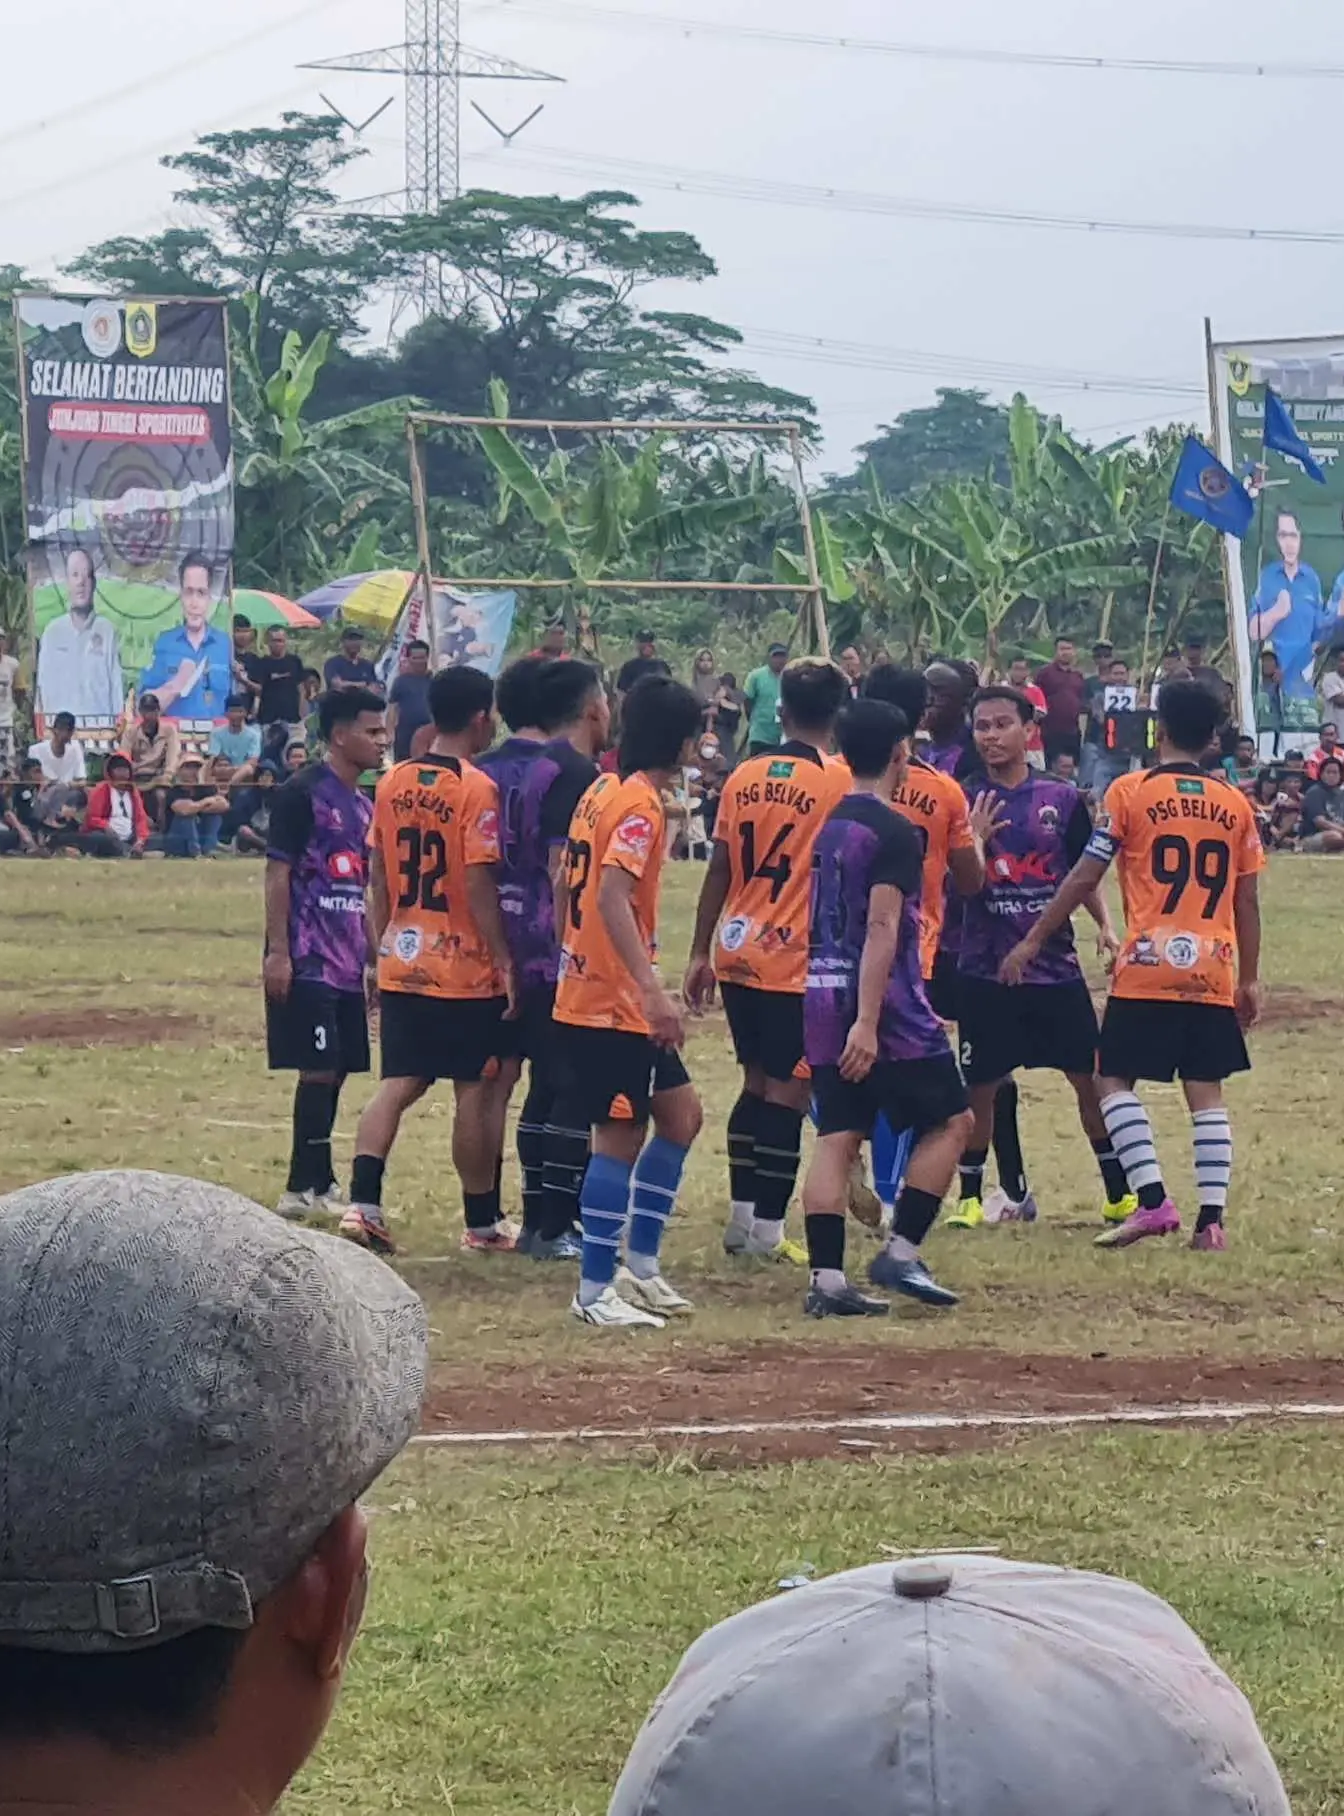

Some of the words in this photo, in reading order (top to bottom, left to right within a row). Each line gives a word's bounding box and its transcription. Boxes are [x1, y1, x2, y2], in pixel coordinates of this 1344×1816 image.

[31, 360, 112, 399] SELAMAT
[113, 364, 224, 403] BERTANDING
[49, 408, 100, 432] JUNJUNG
[101, 410, 137, 434] TINGGI
[137, 412, 206, 437] SPORTIVITAS
[1108, 695, 1132, 713] 22
[735, 782, 760, 811] PSG
[764, 782, 816, 815] BELVAS
[890, 785, 937, 816] ELVAS
[1146, 798, 1178, 826] PSG
[1180, 798, 1237, 832] BELVAS
[397, 826, 449, 913] 32
[739, 820, 796, 904] 14
[1151, 834, 1230, 920] 99
[315, 1025, 326, 1050] 3
